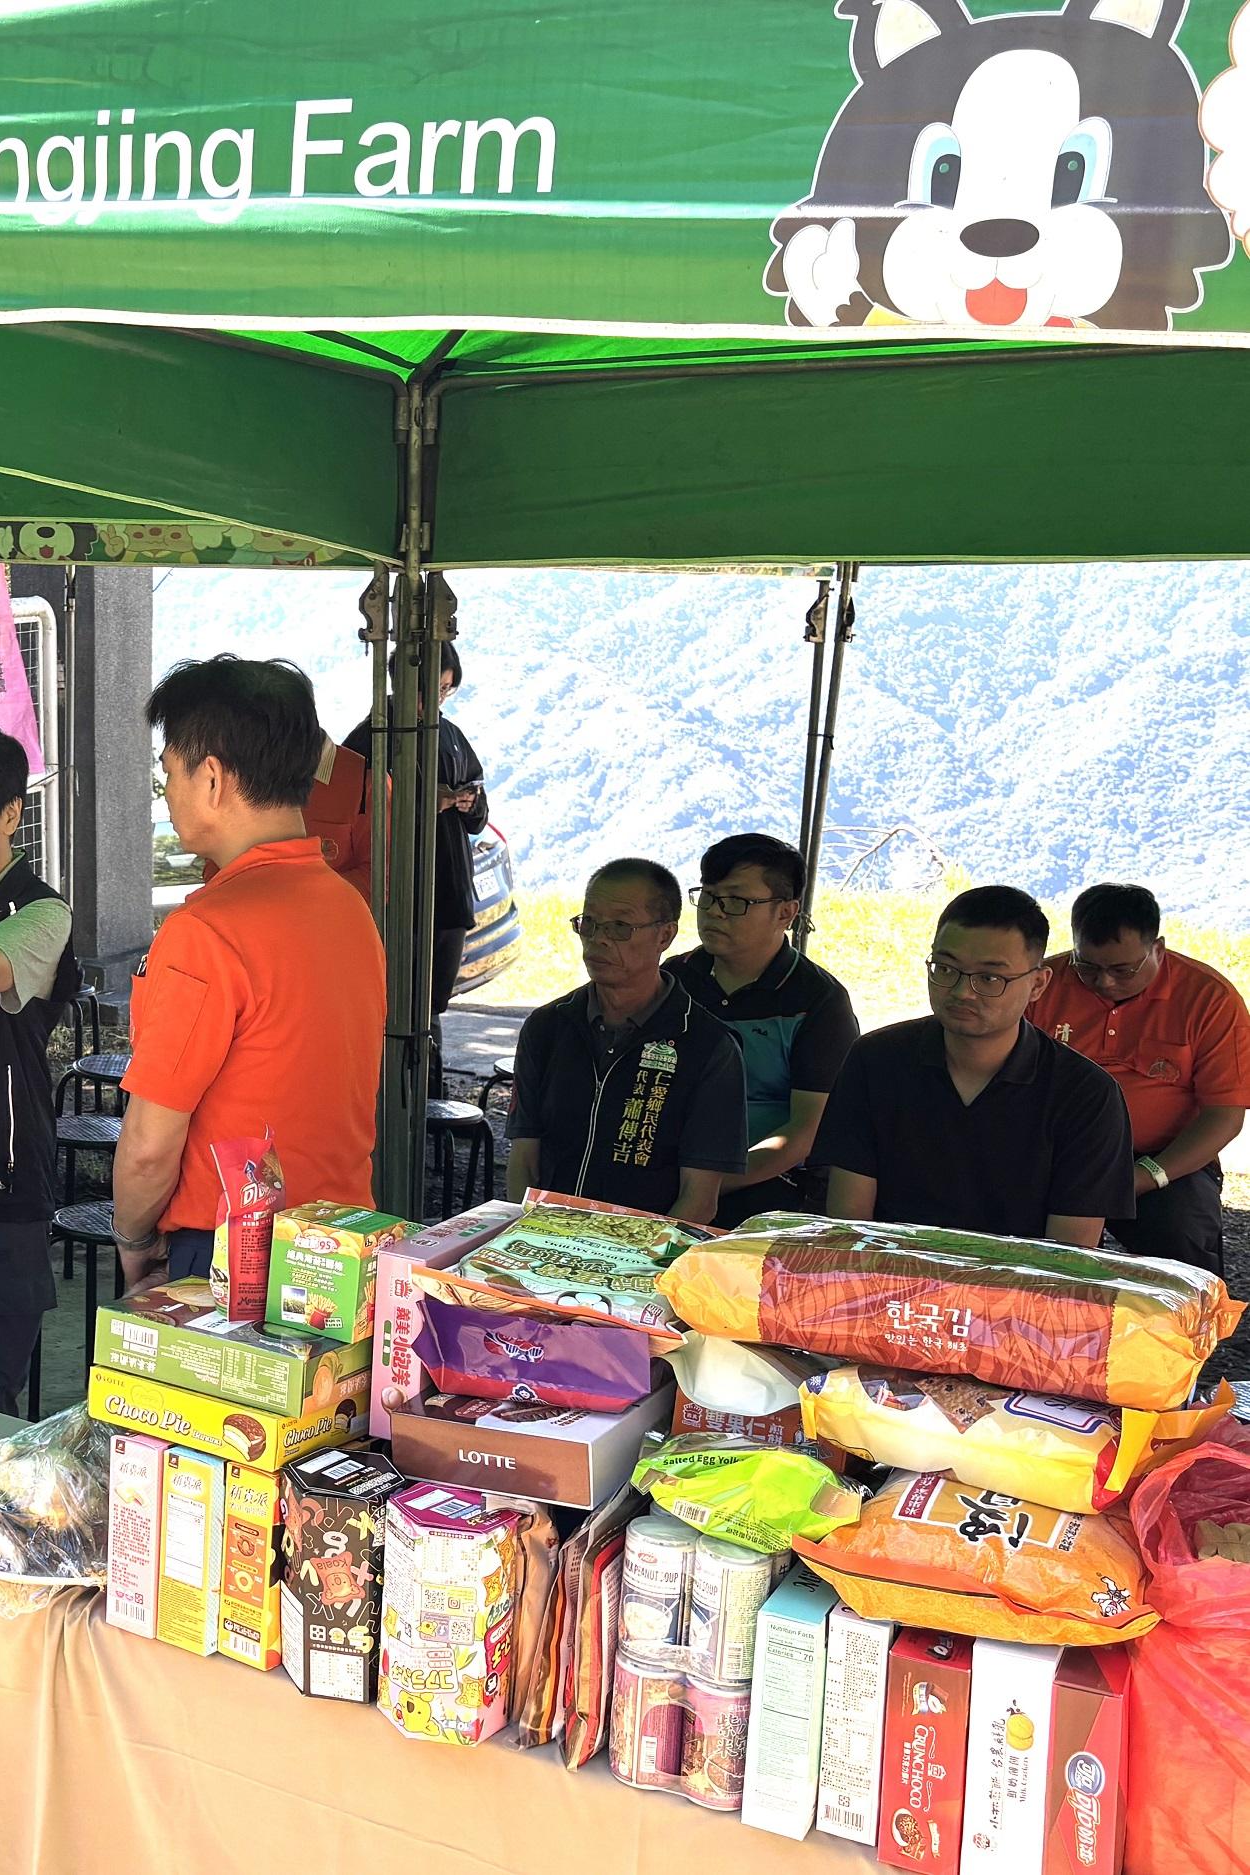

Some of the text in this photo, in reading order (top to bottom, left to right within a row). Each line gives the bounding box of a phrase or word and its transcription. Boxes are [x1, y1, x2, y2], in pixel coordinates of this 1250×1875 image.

[290, 98, 557, 199] Farm
[634, 1072, 672, 1168] 仁愛鄉民代表會
[886, 1300, 972, 1338] 한국김
[922, 1335, 944, 1350] 한국
[104, 1395, 160, 1426] Choco
[160, 1409, 192, 1435] Pie
[284, 1416, 333, 1448] Choco Pie
[705, 1407, 767, 1443] 雙果仁
[458, 1448, 517, 1471] LOTTE
[662, 1454, 695, 1467] Salted
[696, 1453, 717, 1467] Egg
[316, 1558, 348, 1572] Koala
[909, 1724, 930, 1809] CRUNCHOCO
